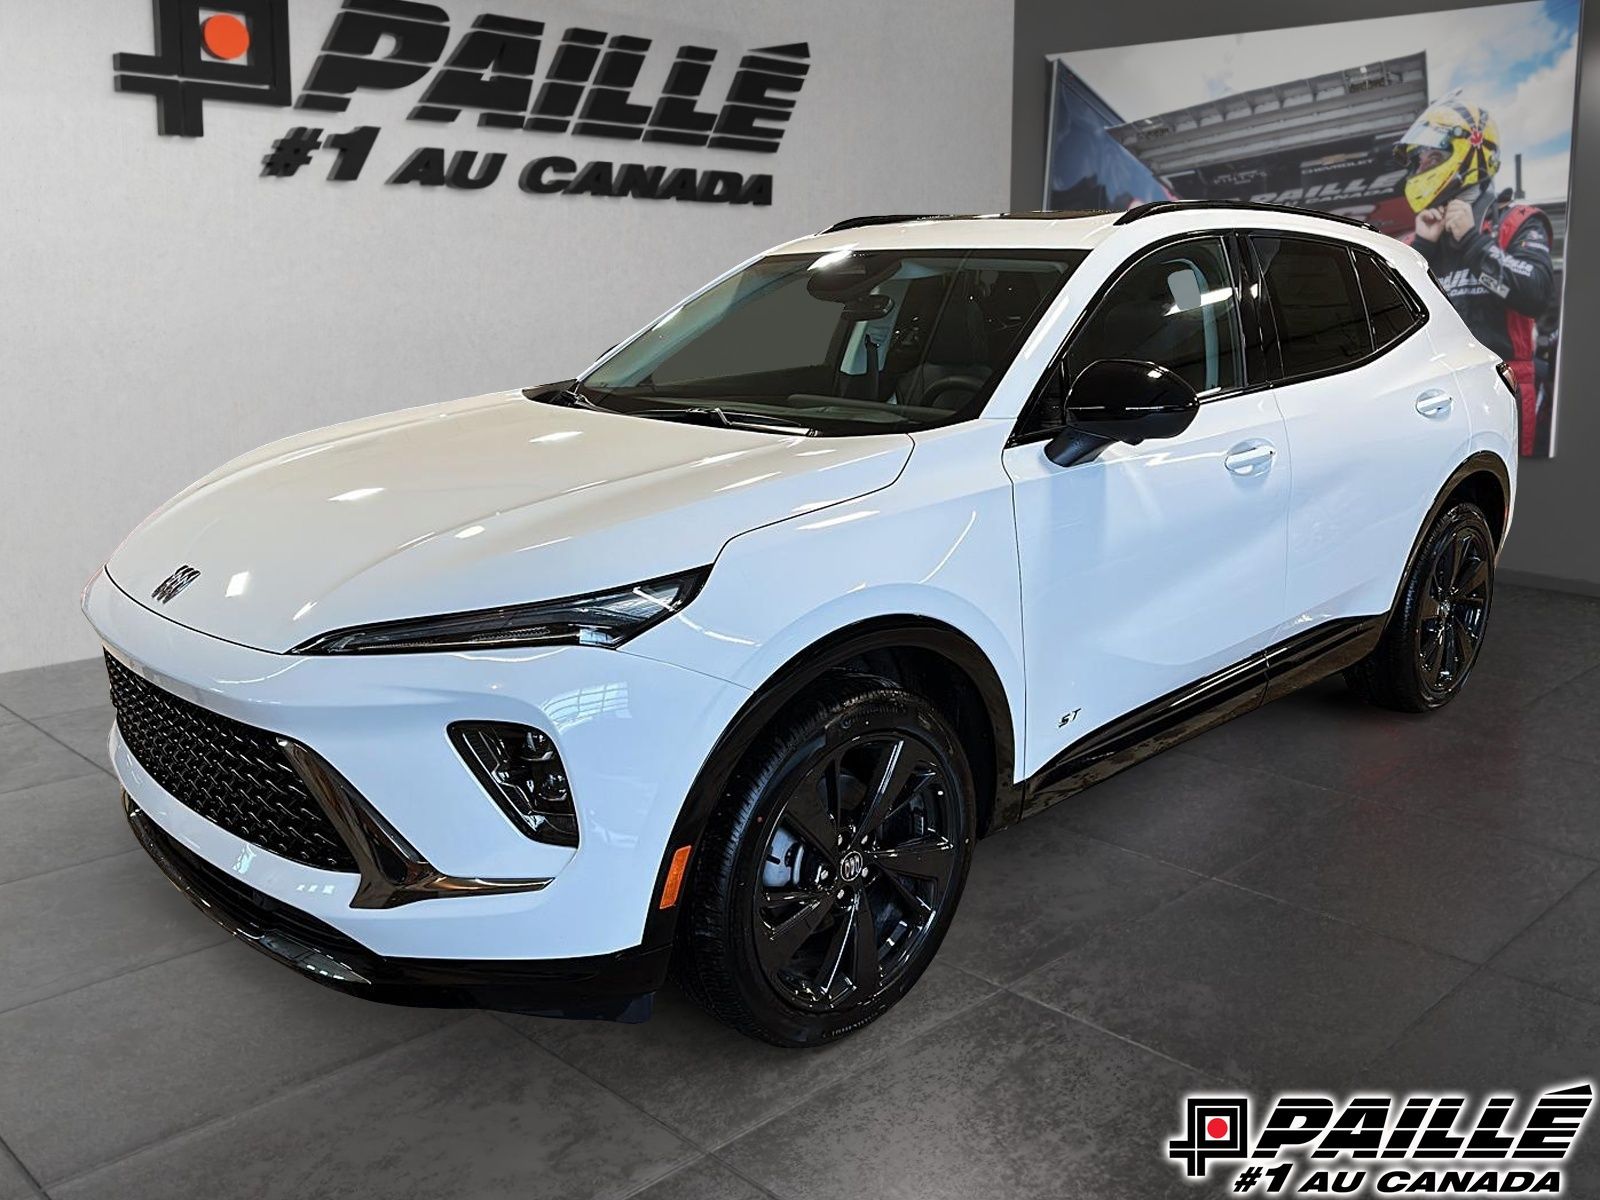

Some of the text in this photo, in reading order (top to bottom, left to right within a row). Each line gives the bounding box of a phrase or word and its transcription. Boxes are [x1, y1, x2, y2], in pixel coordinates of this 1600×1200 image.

[293, 0, 811, 154] PAILLÉ
[259, 126, 773, 206] #1 AU CANADA
[1058, 707, 1082, 728] ST
